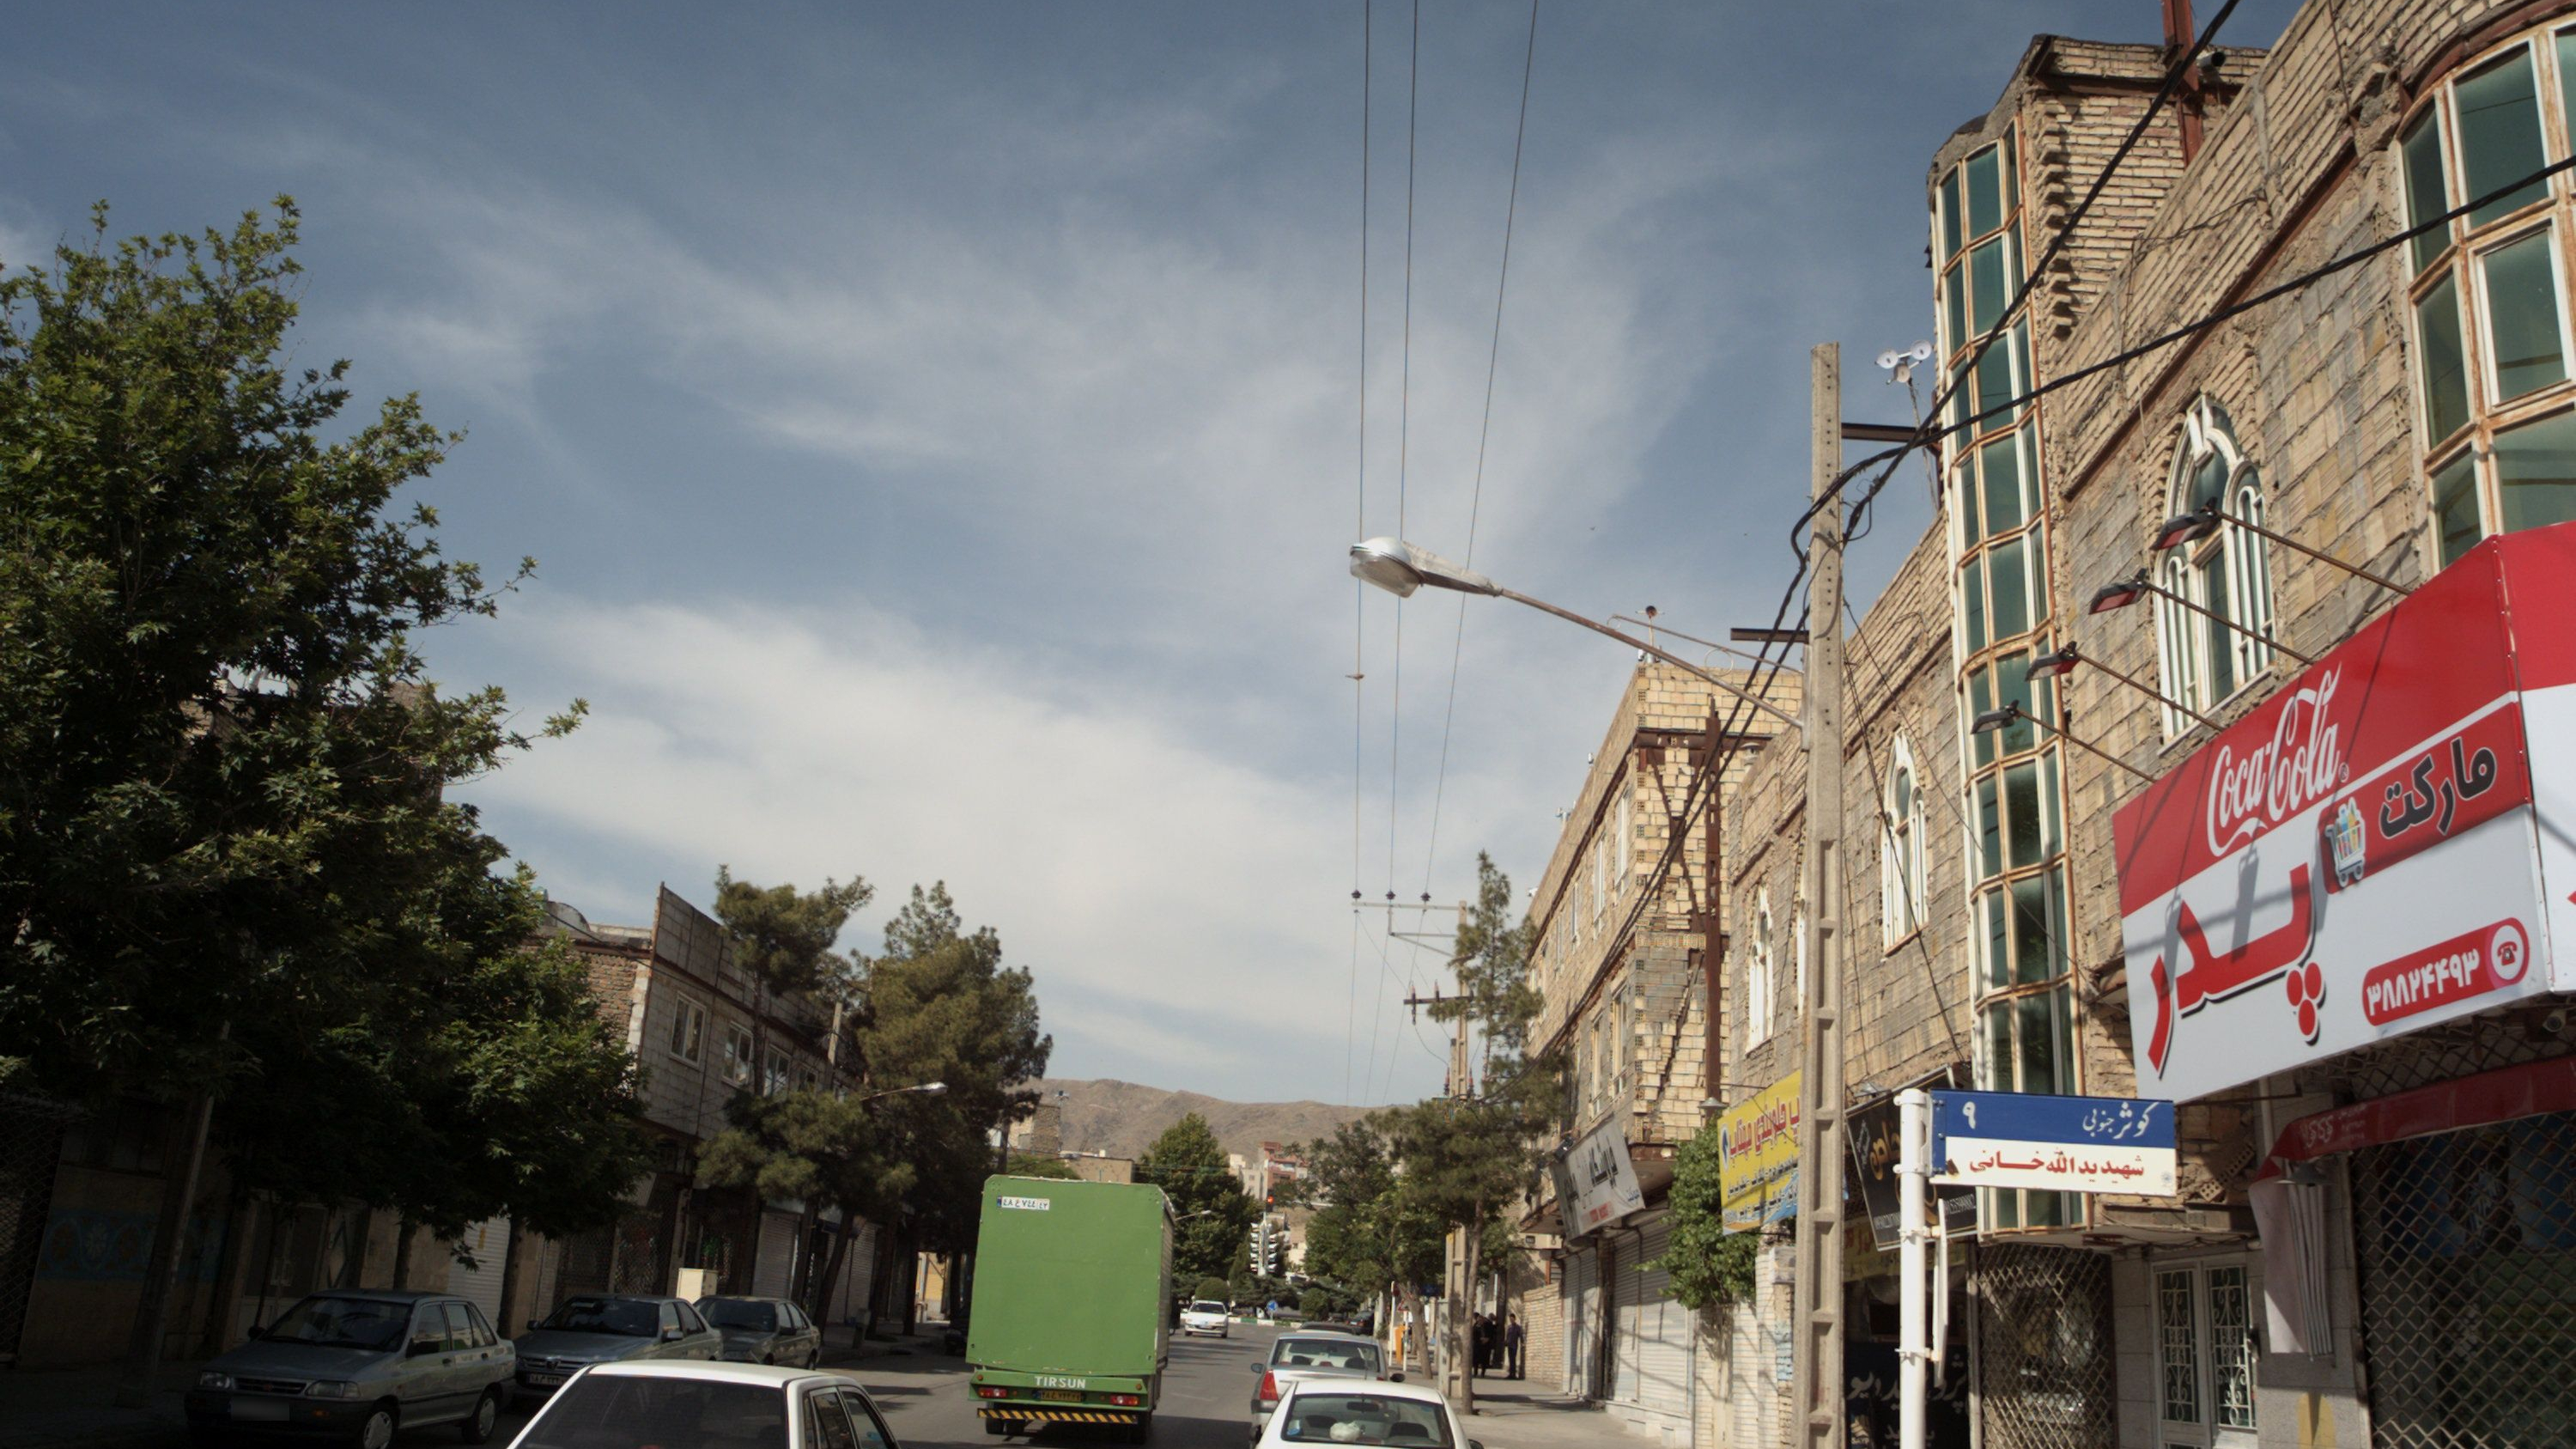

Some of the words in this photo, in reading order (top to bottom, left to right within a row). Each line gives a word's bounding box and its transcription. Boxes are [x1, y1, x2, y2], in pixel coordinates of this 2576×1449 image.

[2379, 736, 2497, 837] مارکت
[2148, 861, 2324, 1078] پدر
[2366, 948, 2480, 1016] ۳۸۸۲۴۴۹۳
[1962, 1101, 1976, 1129] ۹
[2082, 1108, 2115, 1136] جنوبی
[2113, 1101, 2160, 1139] کوثر
[1970, 1149, 2044, 1172] خانی
[2100, 1154, 2144, 1184] شهید
[1034, 1376, 1086, 1389] TIRSUN
